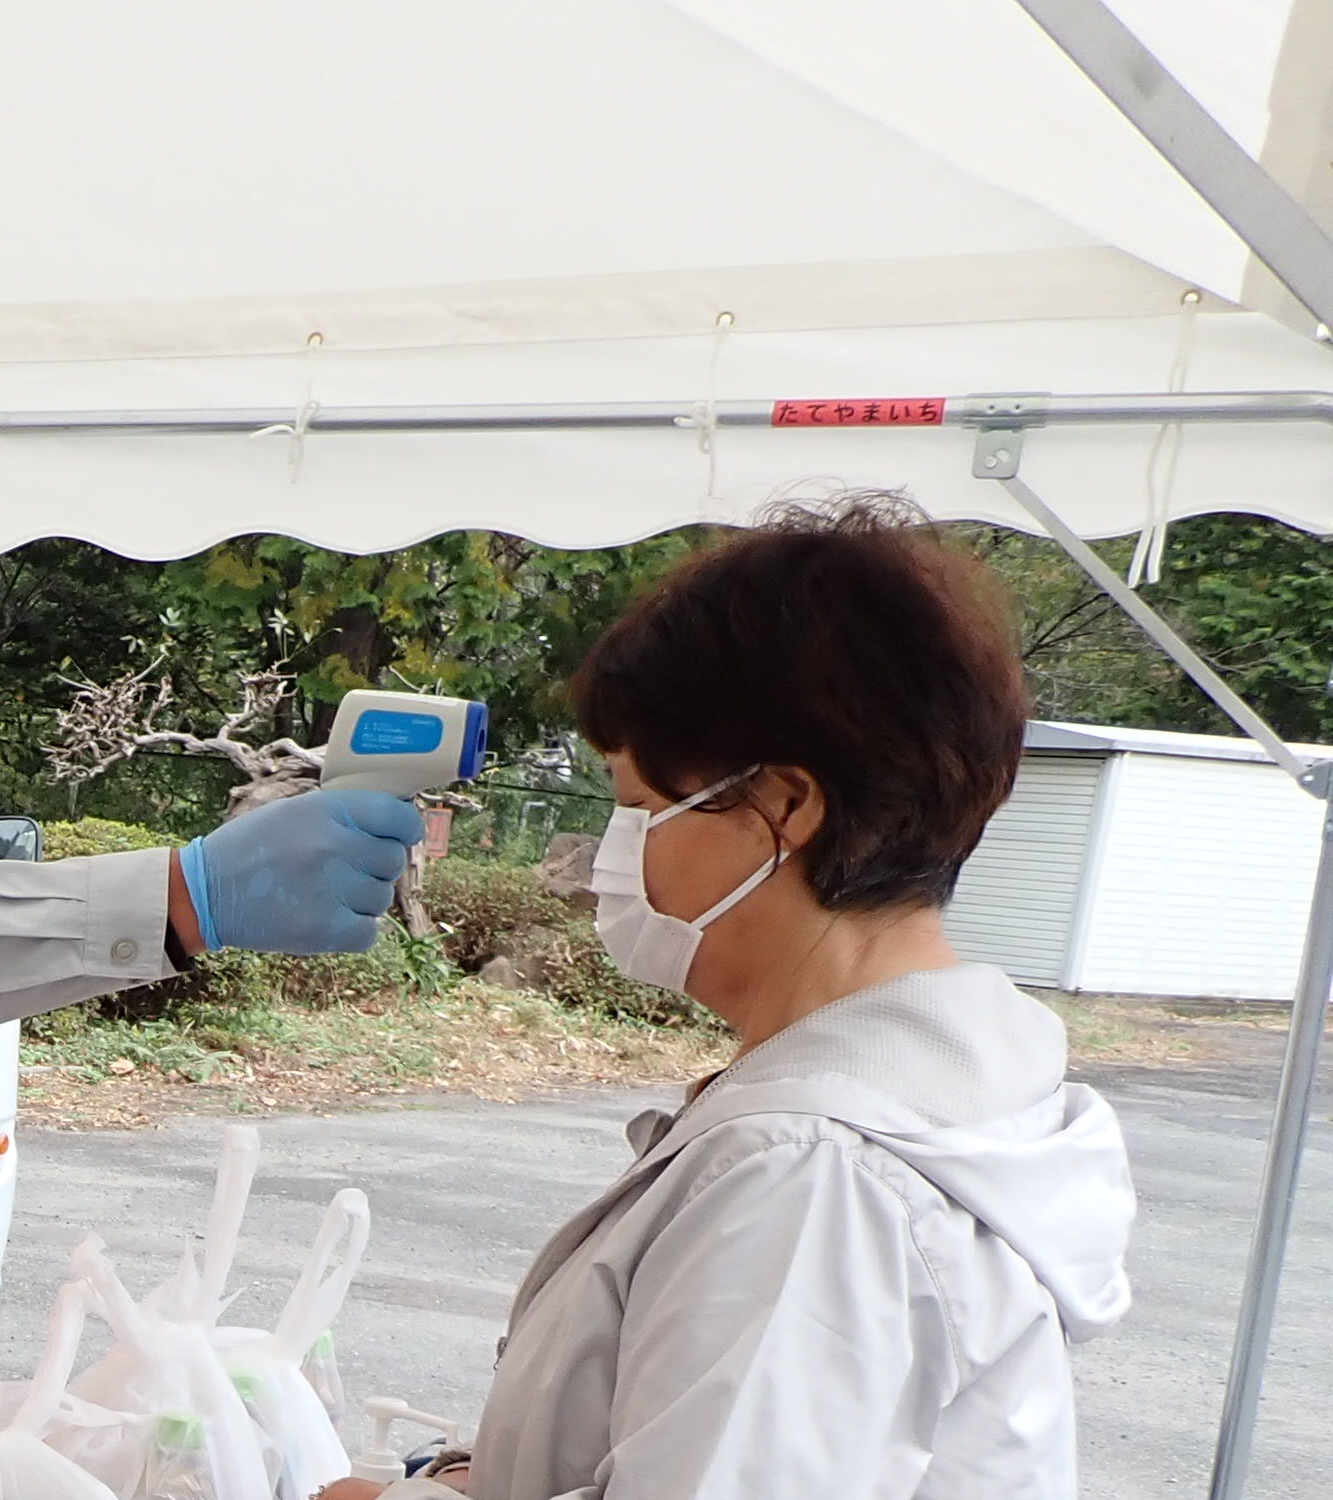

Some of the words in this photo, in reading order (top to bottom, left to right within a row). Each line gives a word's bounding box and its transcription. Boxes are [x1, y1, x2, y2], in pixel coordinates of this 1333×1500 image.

[778, 400, 939, 425] たてやまいち
